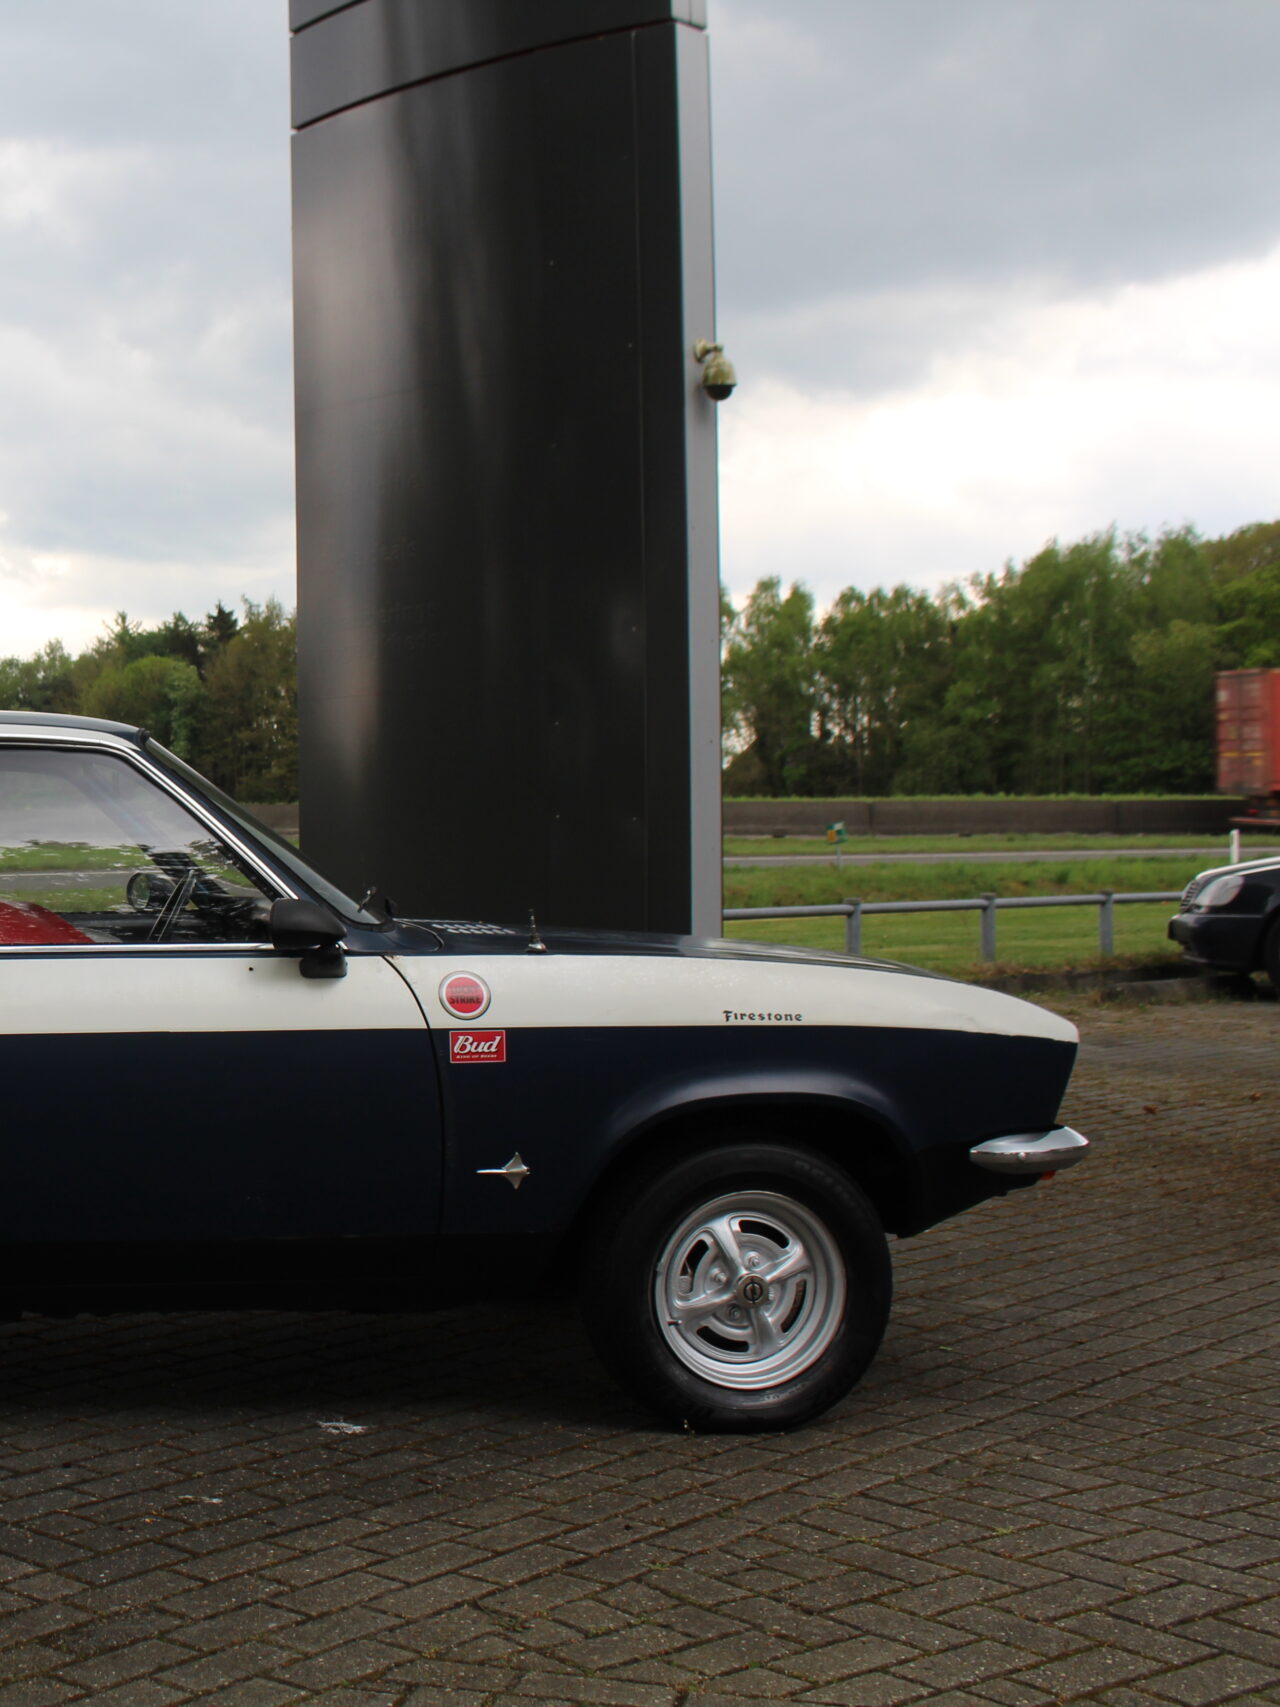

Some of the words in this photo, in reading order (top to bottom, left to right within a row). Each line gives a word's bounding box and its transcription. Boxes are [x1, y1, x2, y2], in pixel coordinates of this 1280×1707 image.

[449, 995, 482, 1005] STRIKE
[722, 1010, 803, 1022] Firestone
[453, 1035, 502, 1054] Bud
